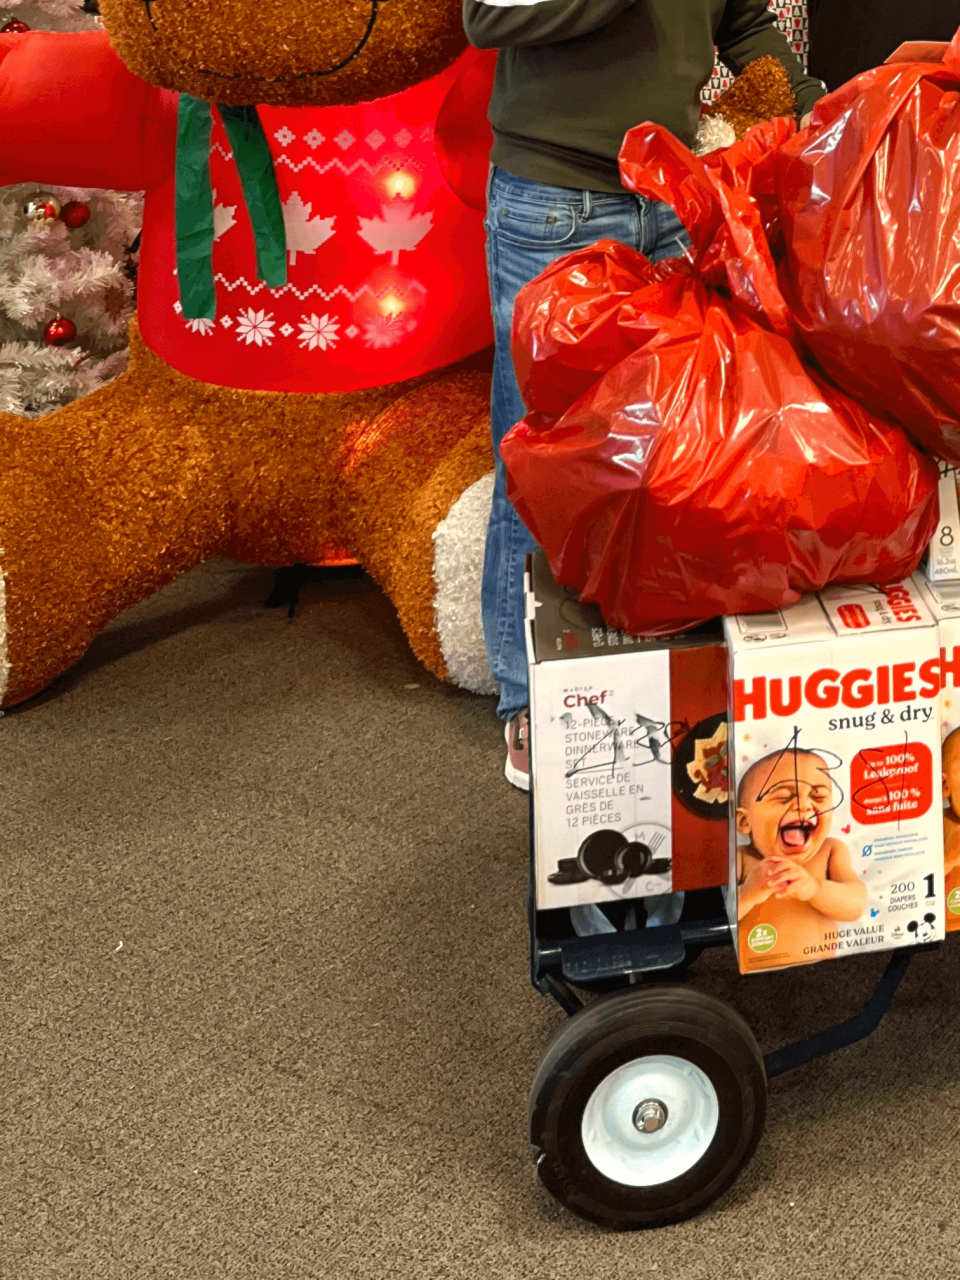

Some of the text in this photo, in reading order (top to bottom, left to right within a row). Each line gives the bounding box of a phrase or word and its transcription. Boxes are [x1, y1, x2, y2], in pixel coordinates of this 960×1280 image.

[939, 526, 954, 547] 8
[879, 583, 922, 622] UGGIES
[734, 657, 941, 723] HUGGIES
[563, 690, 608, 709] Chef
[828, 705, 933, 731] snug & dry
[564, 726, 635, 744] STONEWARE
[564, 739, 640, 757] DINNERWARE
[564, 757, 587, 770] SET
[885, 752, 915, 765] 100%
[863, 762, 919, 780] Leakproof
[565, 772, 631, 789] SERVICE DE
[565, 784, 644, 802] VAISSELLE EN
[889, 789, 909, 802] 100
[910, 788, 921, 798] %
[599, 800, 614, 812] DE
[892, 799, 918, 812] fuite
[566, 812, 622, 828] 12 PIÈCES
[890, 872, 936, 899] 200 1
[887, 902, 918, 913] COUCHES
[890, 894, 916, 905] DIAPERS
[824, 924, 885, 941] HUGE VALUE
[802, 935, 885, 955] GRANDE VALEUR
